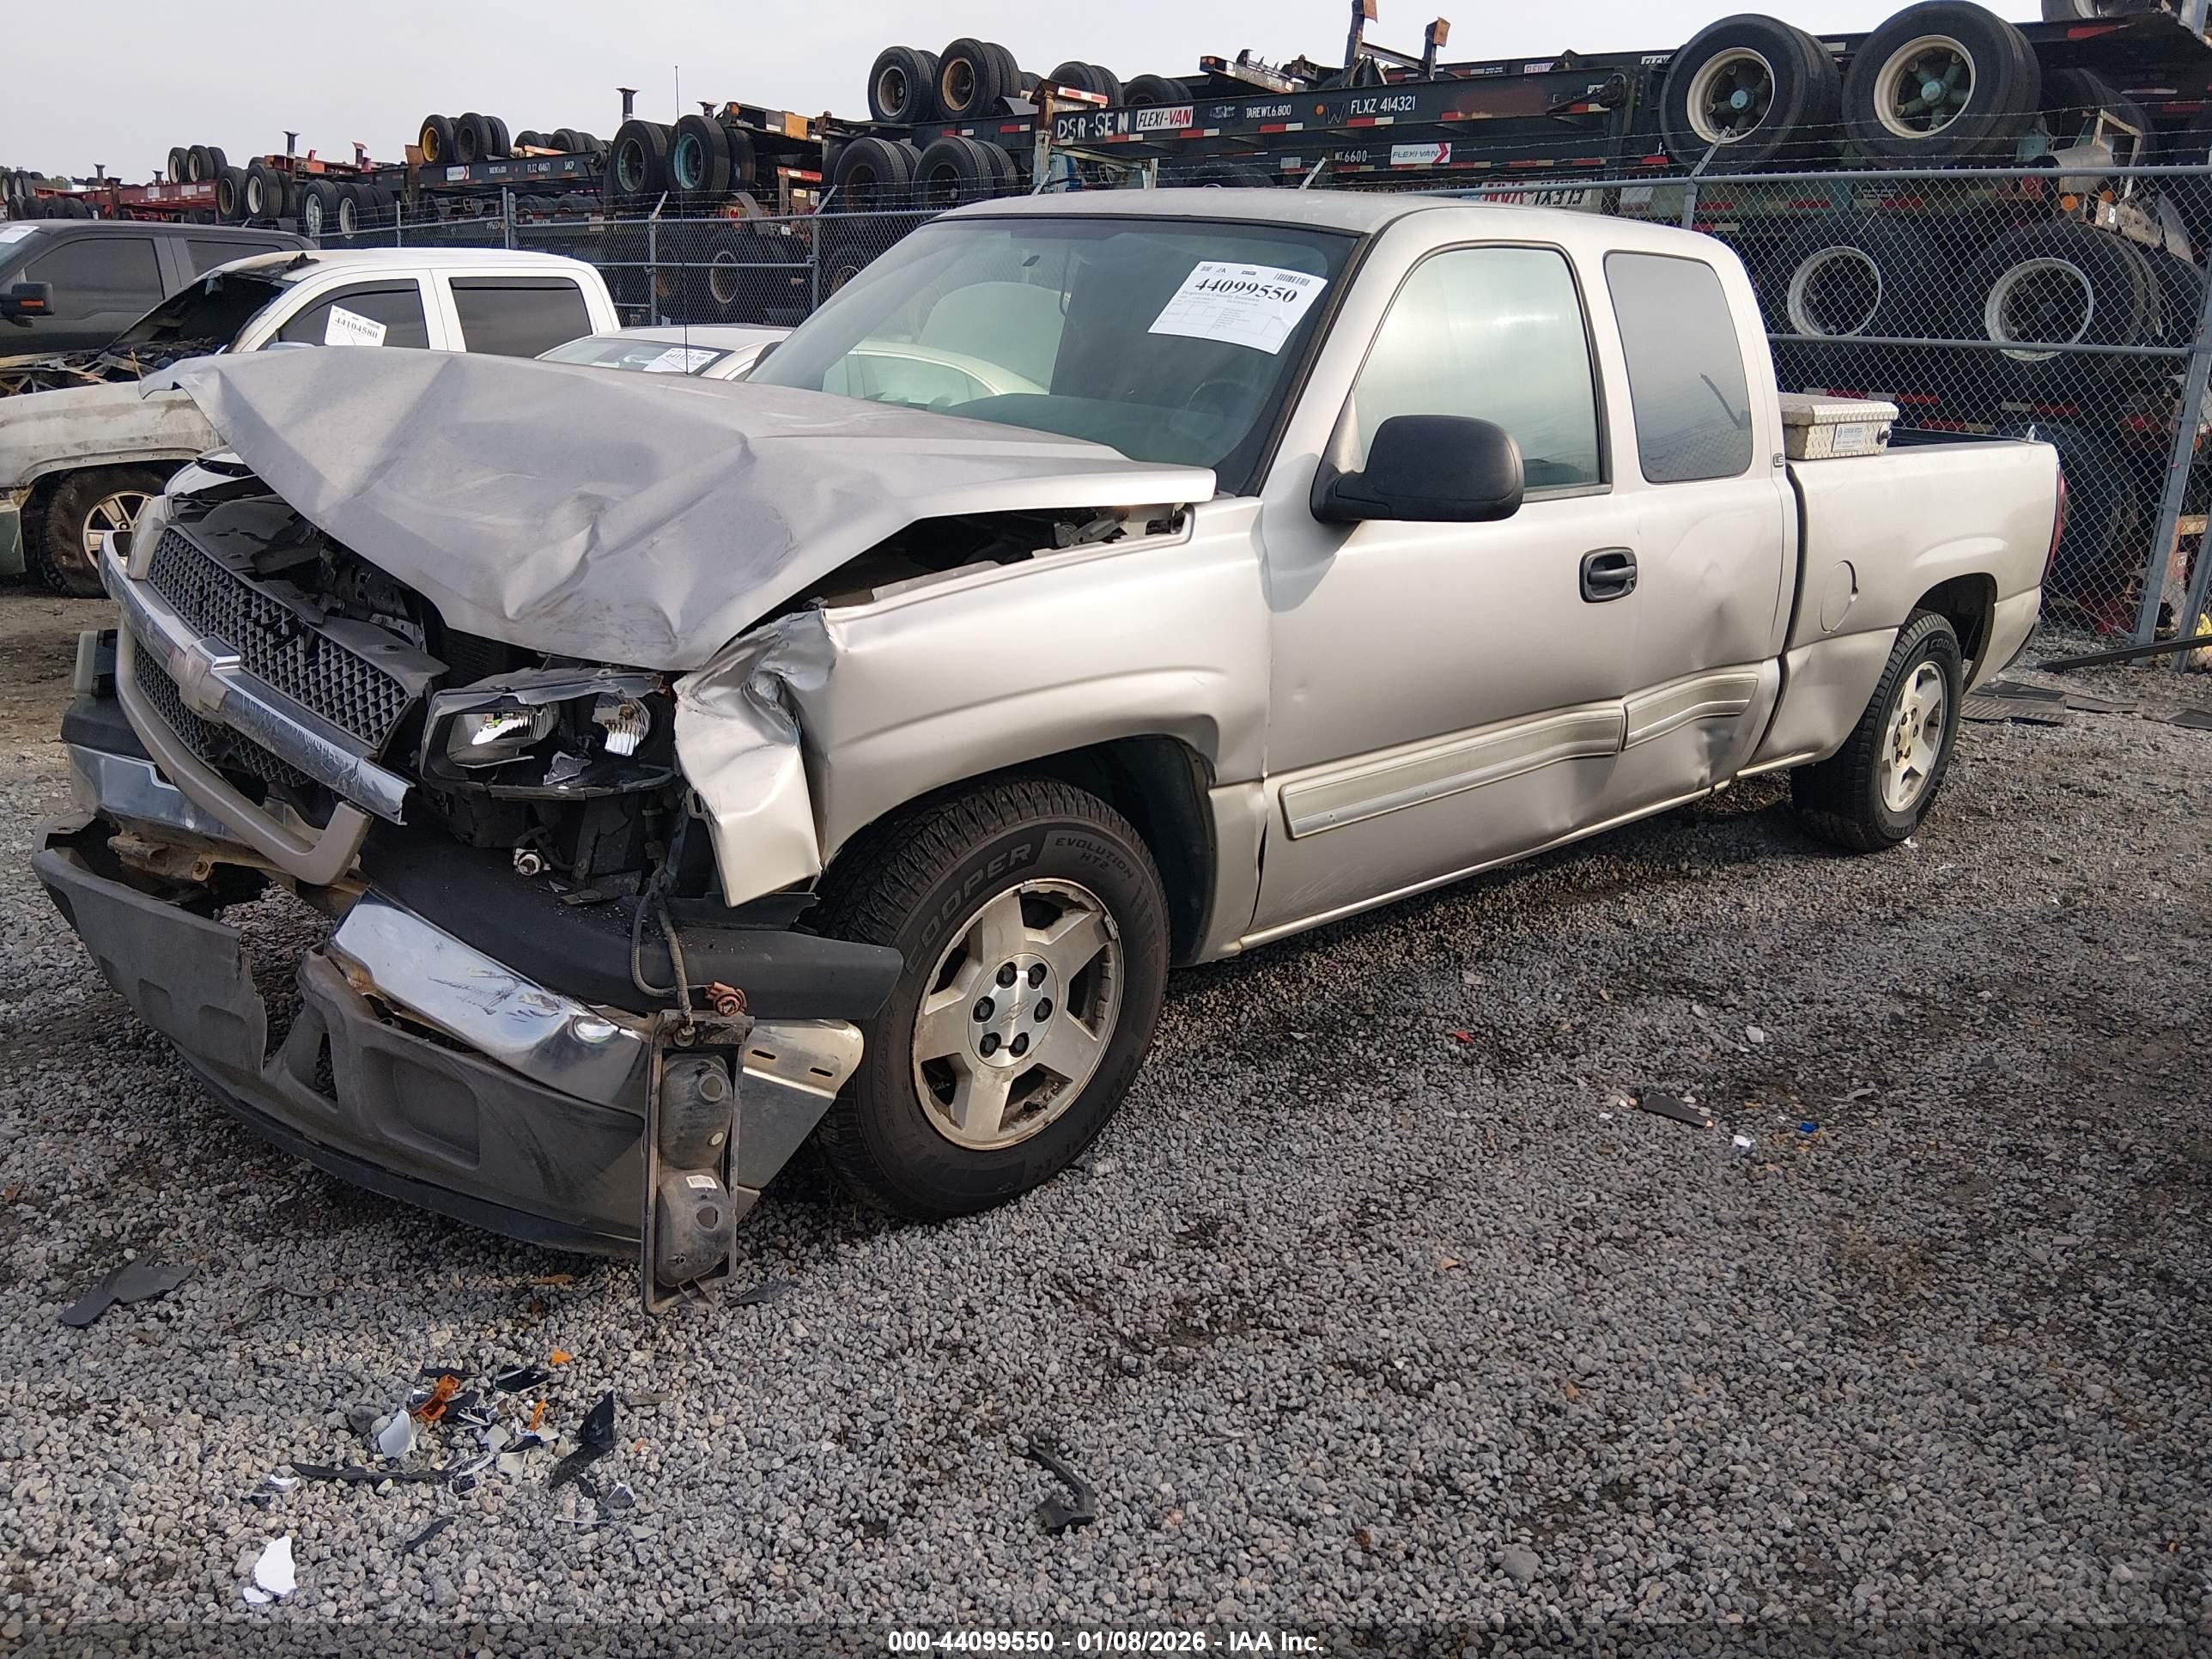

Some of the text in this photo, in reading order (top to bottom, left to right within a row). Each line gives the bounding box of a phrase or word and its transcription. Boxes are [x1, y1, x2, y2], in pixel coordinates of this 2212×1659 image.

[1350, 95, 1416, 115] FLXZ 414321
[1137, 109, 1192, 128] FLEXI-VAN
[1344, 149, 1368, 163] 6600
[1194, 277, 1297, 303] 44099550
[1054, 836, 1134, 879] EVOLUTION
[905, 843, 1031, 975] COOPER
